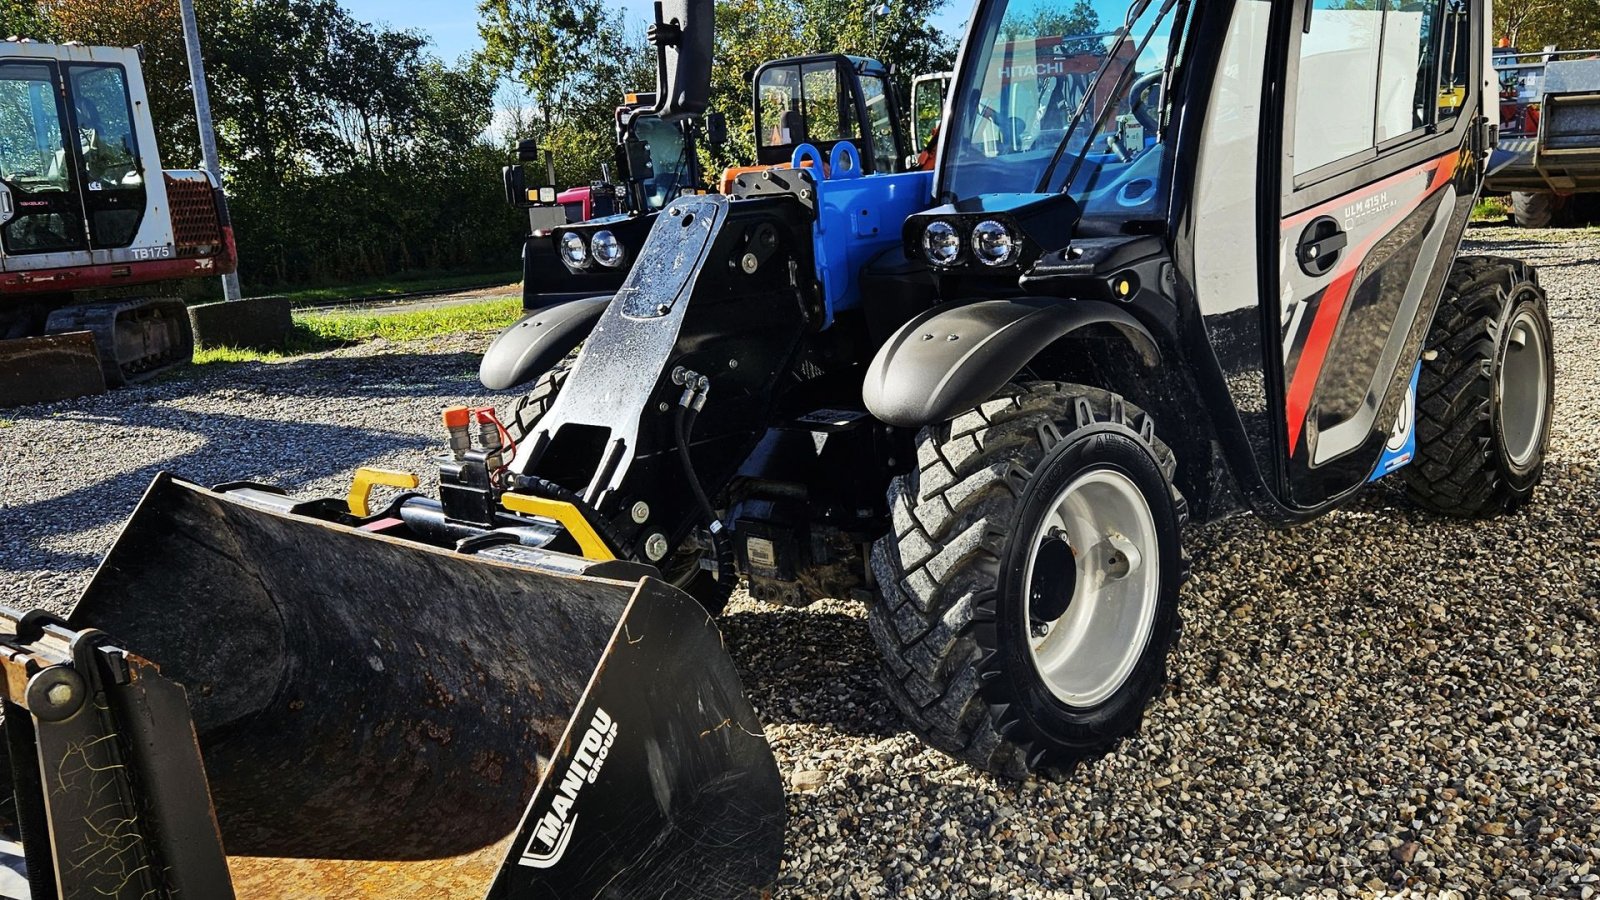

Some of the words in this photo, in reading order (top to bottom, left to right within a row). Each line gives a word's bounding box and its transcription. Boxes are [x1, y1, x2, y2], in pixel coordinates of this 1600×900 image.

[998, 62, 1064, 79] HITACHI
[1344, 201, 1363, 218] ULM
[1364, 195, 1379, 209] 415
[1380, 191, 1387, 204] H
[131, 246, 169, 260] TB175
[587, 721, 619, 785] GROUP
[537, 706, 613, 849] MANITOU
